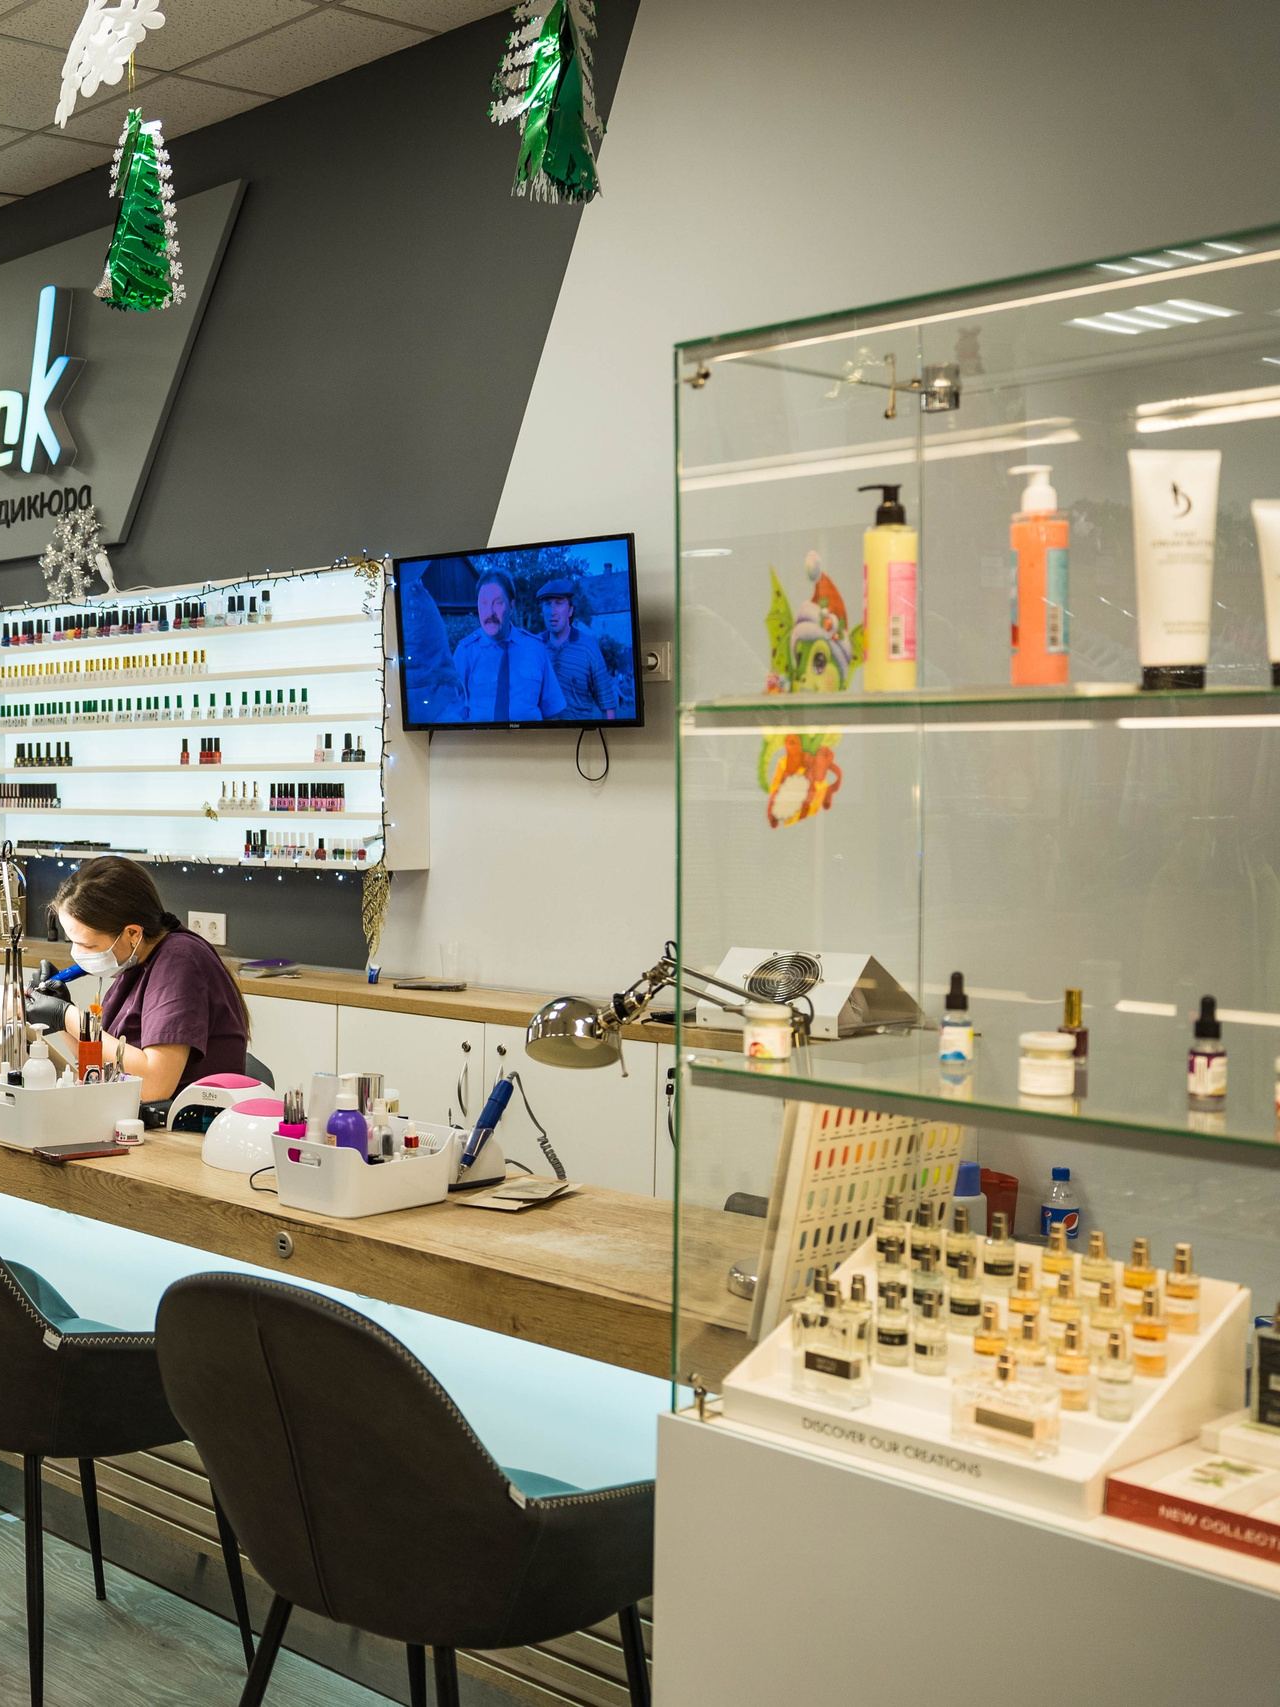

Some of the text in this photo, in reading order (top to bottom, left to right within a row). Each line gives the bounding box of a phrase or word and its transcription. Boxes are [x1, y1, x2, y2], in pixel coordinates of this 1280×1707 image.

[802, 1416, 982, 1478] DISCOVER OUR CREATIONS
[1158, 1504, 1198, 1526] NEW
